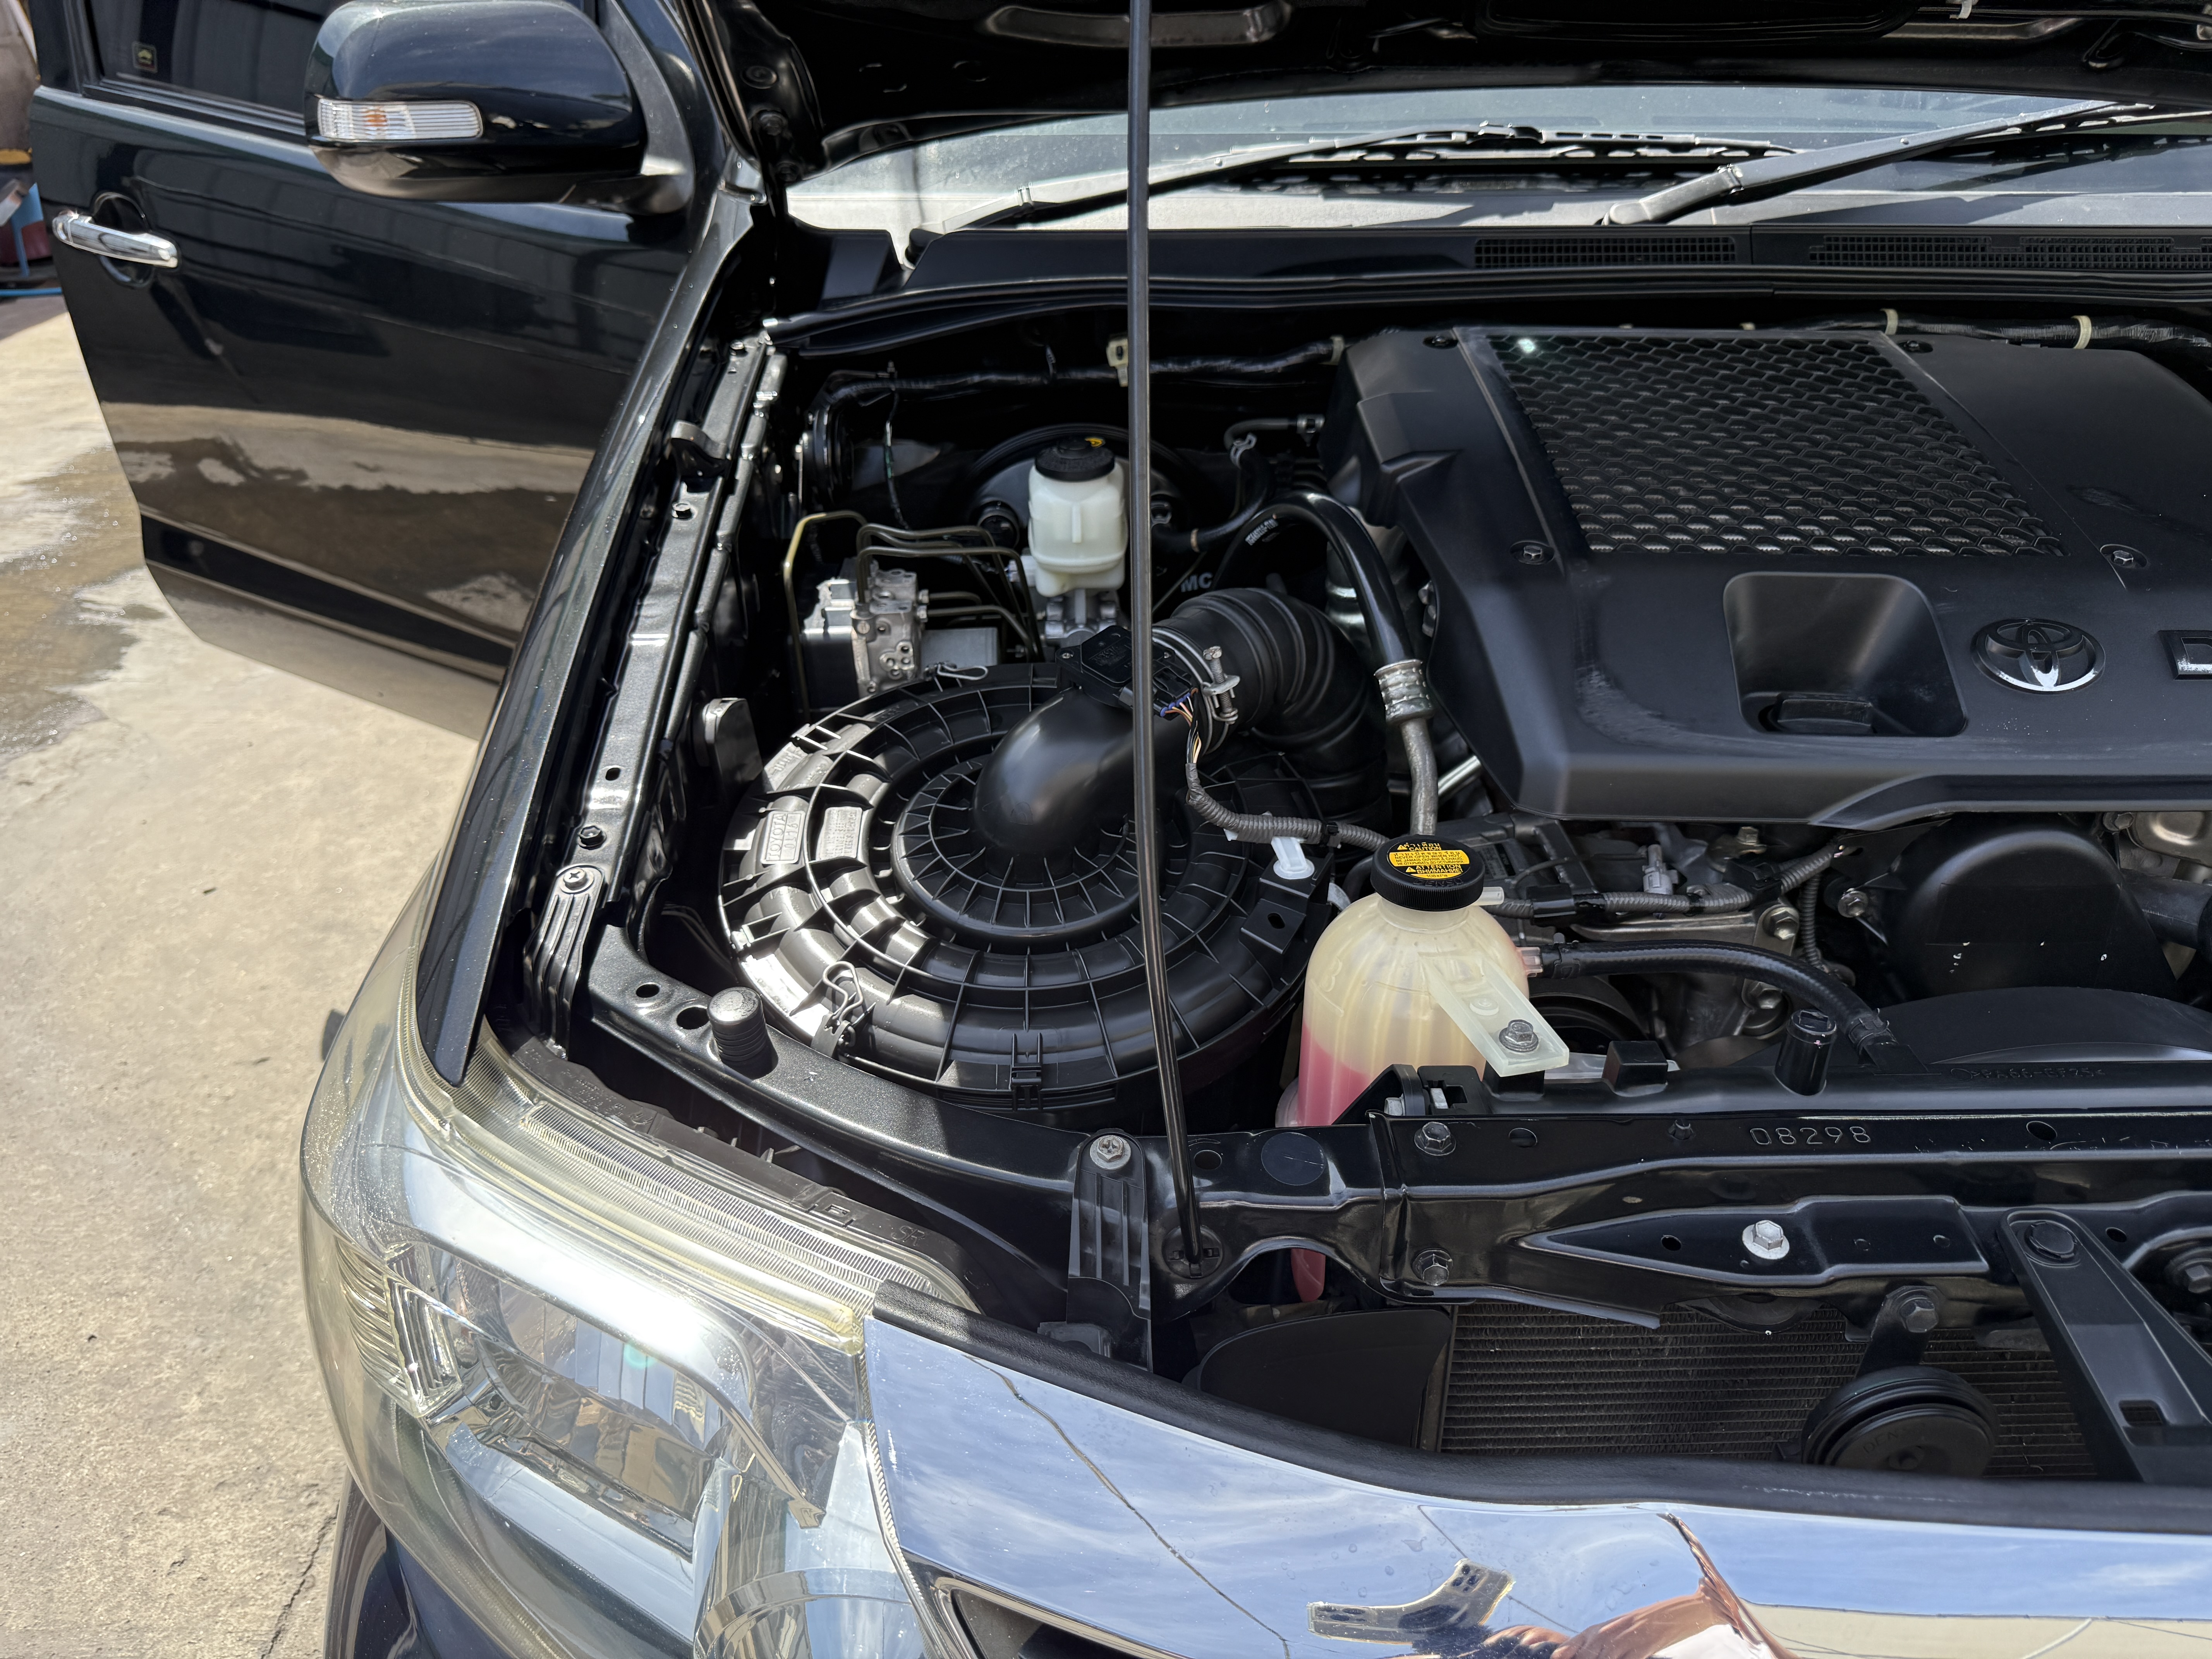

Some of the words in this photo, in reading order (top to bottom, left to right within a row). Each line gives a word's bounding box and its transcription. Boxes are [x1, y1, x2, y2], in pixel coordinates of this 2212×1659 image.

[768, 813, 786, 859] TOYOTA
[1413, 878, 1463, 887] DENSO
[1749, 1126, 1871, 1146] 08298
